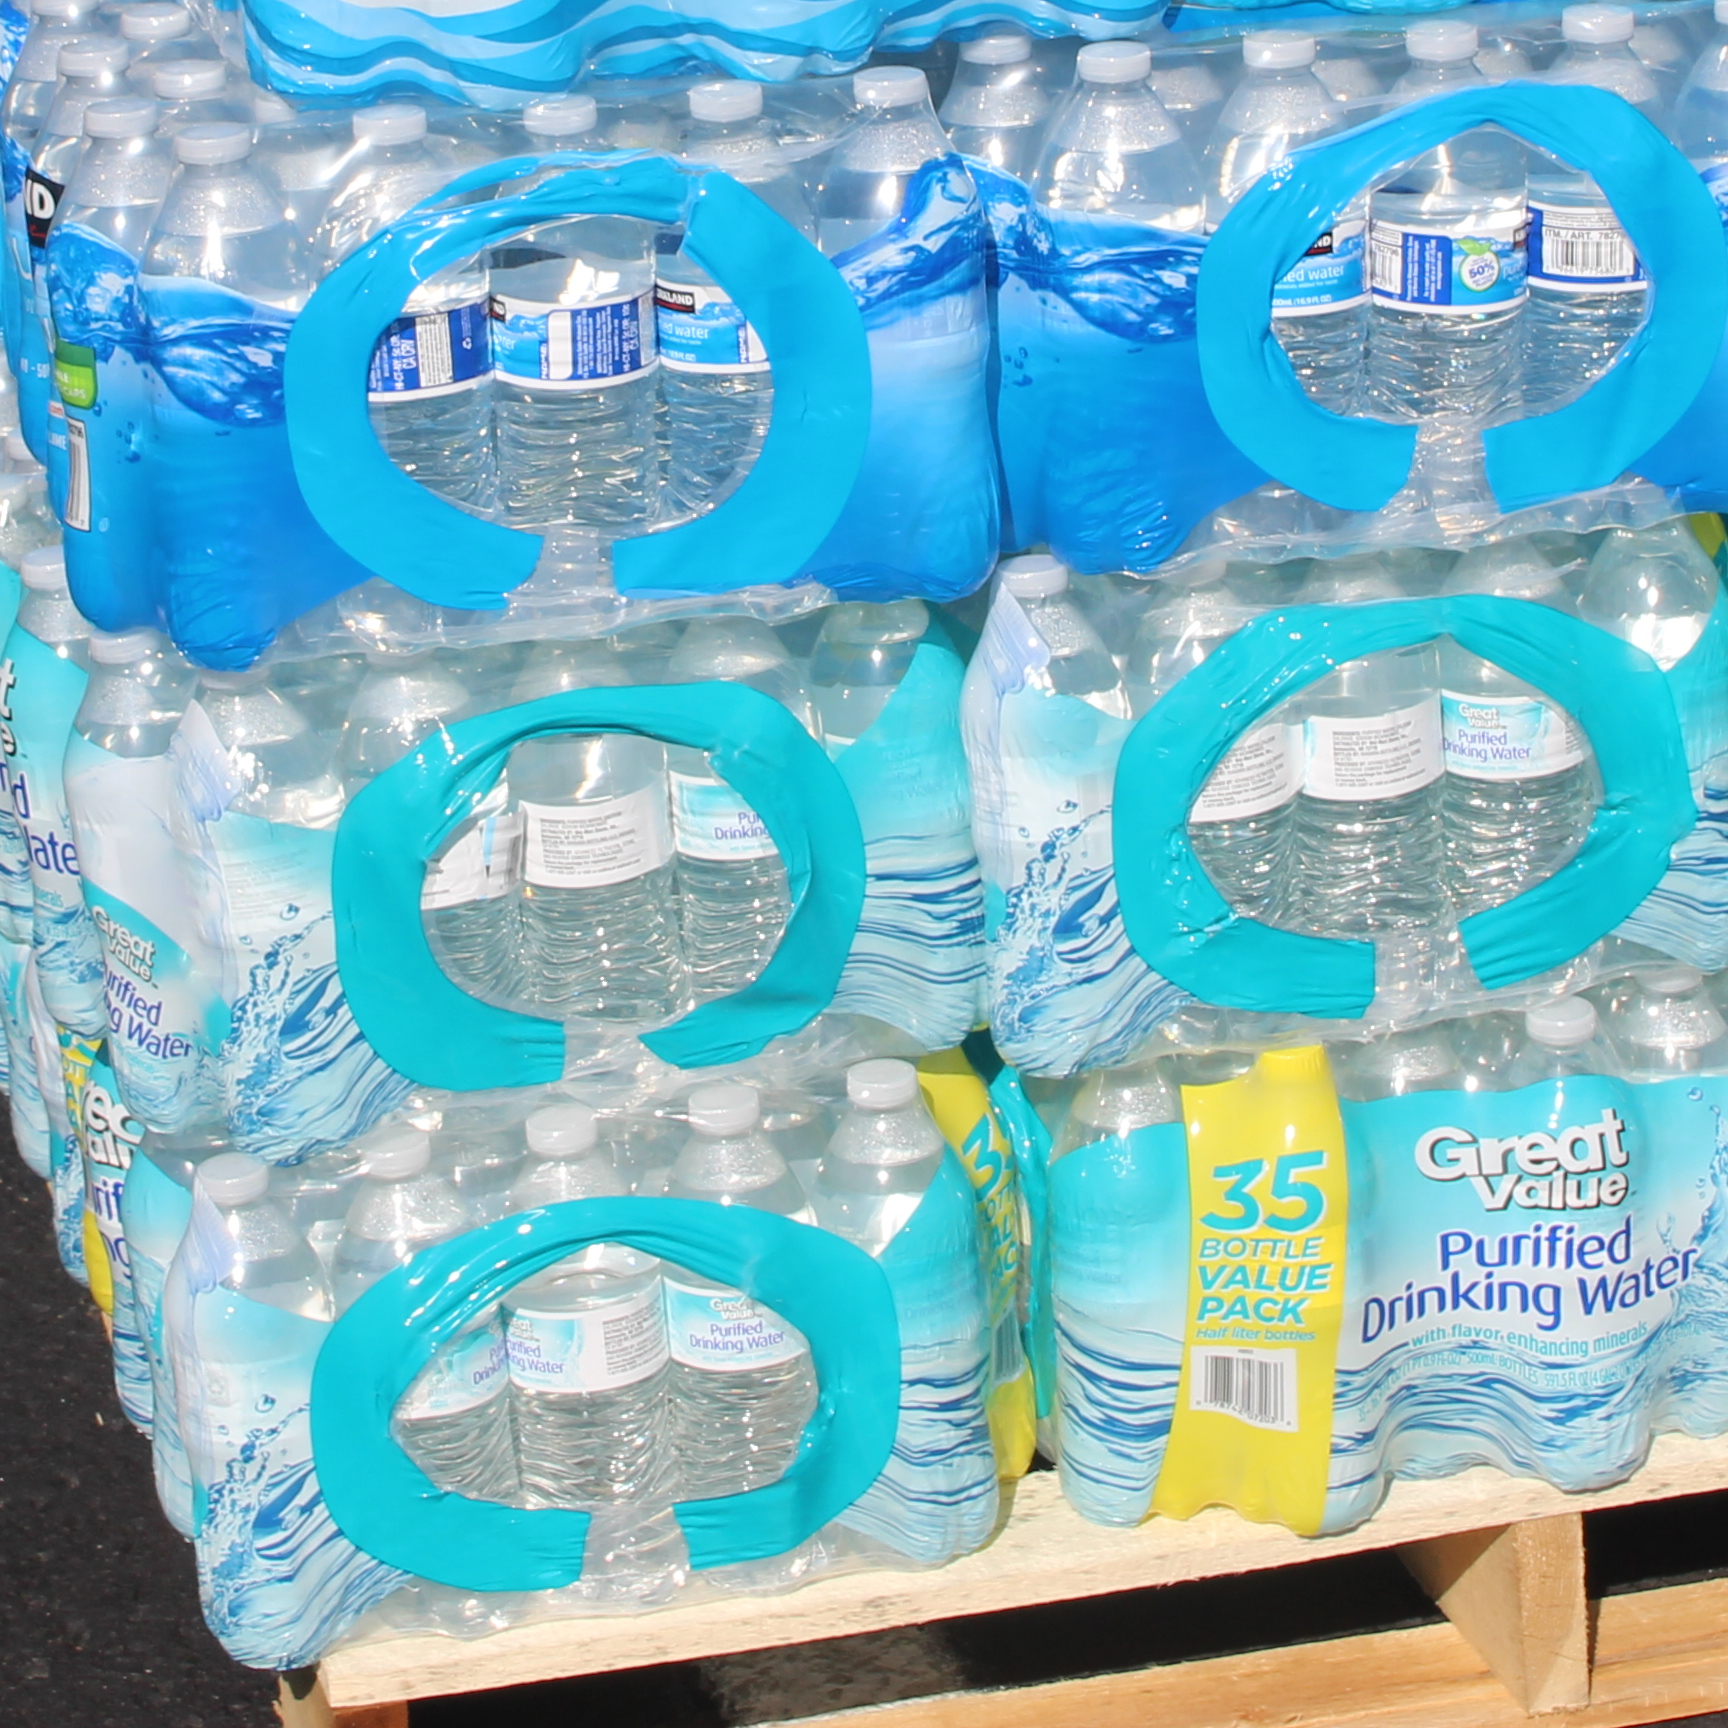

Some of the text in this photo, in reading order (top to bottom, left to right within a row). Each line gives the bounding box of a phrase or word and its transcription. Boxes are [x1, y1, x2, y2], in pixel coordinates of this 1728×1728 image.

[1308, 265, 1345, 281] water
[673, 325, 709, 341] water
[1458, 703, 1500, 720] Great
[1467, 716, 1501, 730] Value
[1442, 737, 1532, 761] Drinking Water
[1458, 729, 1508, 745] Purified
[92, 904, 157, 967] Great
[109, 936, 152, 982] Value
[128, 1015, 194, 1060] Water
[1414, 1108, 1630, 1181] Great
[1198, 1150, 1326, 1233] 35
[1472, 1171, 1630, 1212] Value
[1198, 1236, 1324, 1262] BOTTLE
[1438, 1213, 1633, 1272] Purified
[1197, 1263, 1334, 1293] VALUE
[1361, 1247, 1700, 1344] Drinking Water
[1196, 1295, 1310, 1325] PACK
[709, 1321, 764, 1336] Purified
[1195, 1327, 1316, 1342] Half liter bottles
[1408, 1322, 1649, 1358] with flavor enhancing minerals
[689, 1332, 785, 1354] Drinking Water
[525, 1357, 564, 1374] Water
